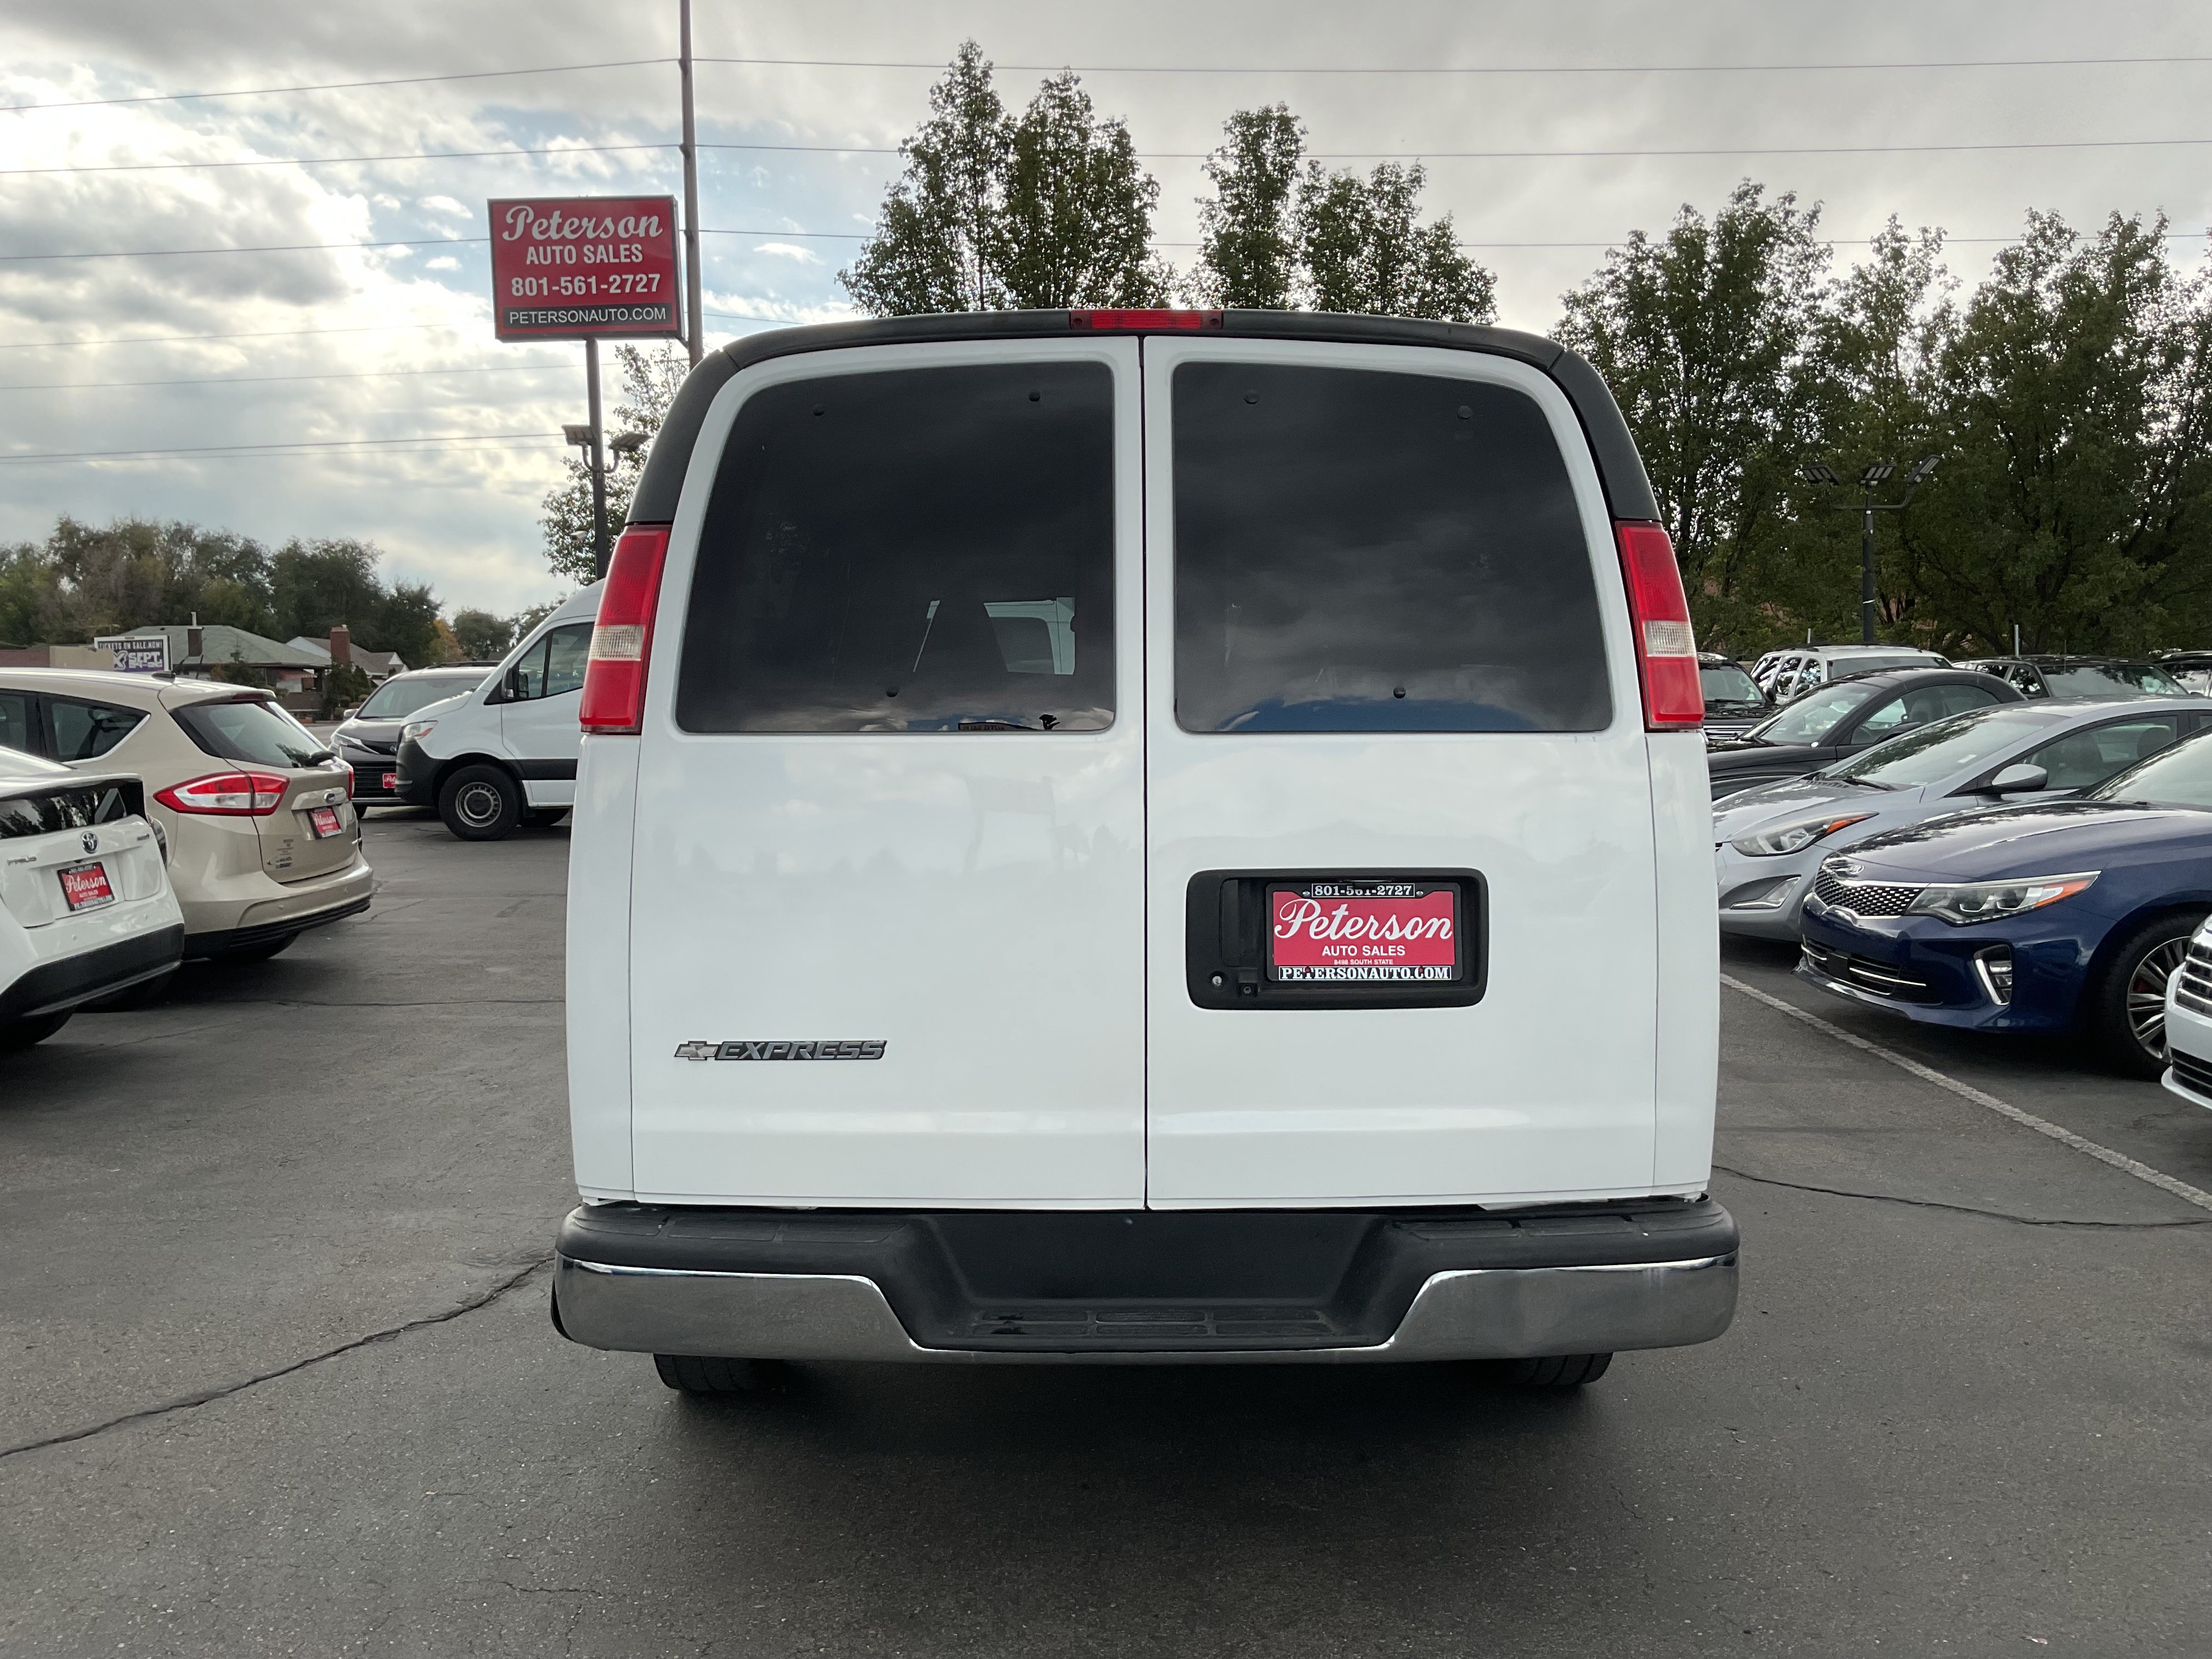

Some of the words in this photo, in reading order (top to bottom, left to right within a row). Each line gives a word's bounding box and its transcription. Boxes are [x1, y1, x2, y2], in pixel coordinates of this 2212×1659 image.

[502, 205, 663, 241] Peterson
[526, 245, 577, 265] AUTO
[583, 243, 643, 264] SALES
[511, 273, 661, 296] 801-561-2727
[510, 307, 666, 324] PETERSONAUTO.COM
[132, 641, 146, 649] SALE
[128, 651, 162, 663] SEPT.
[65, 874, 106, 893] Peterson
[1314, 885, 1412, 896] 801-561-2727
[1274, 898, 1453, 940] Peterson
[1322, 945, 1358, 956] AUTO
[1362, 945, 1406, 956] SALES
[1282, 967, 1448, 979] PETERSONAUTO.COM
[717, 1041, 885, 1059] EXPRESS
